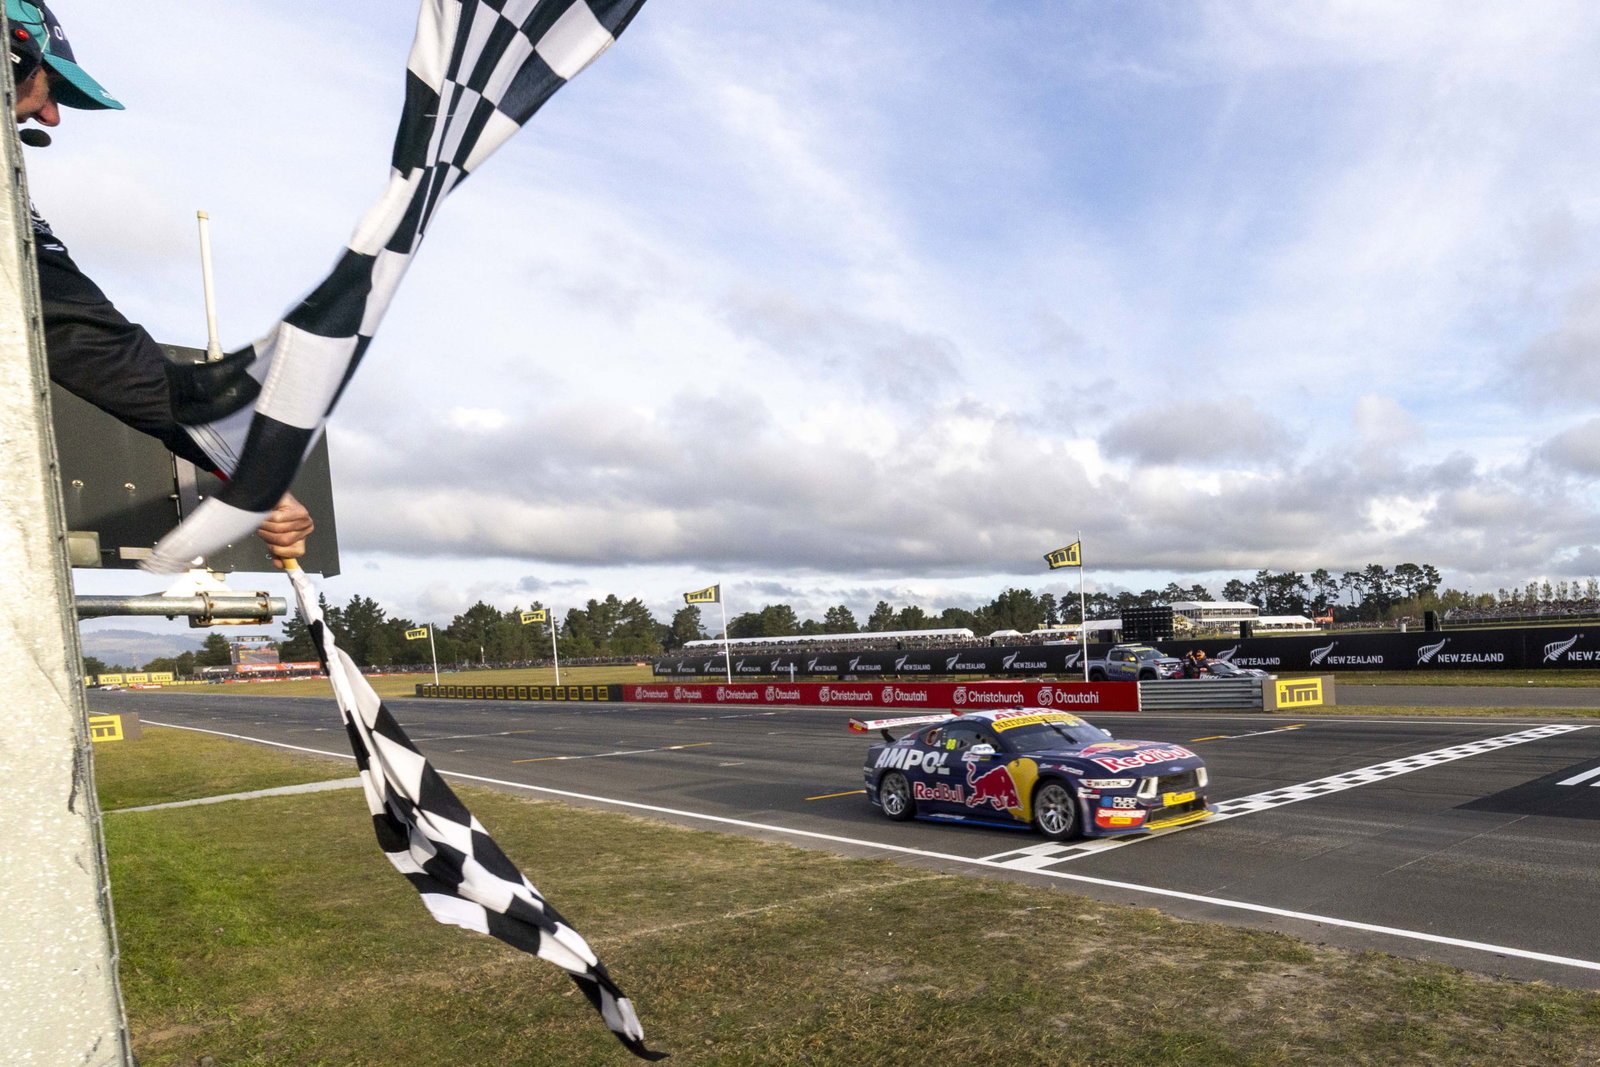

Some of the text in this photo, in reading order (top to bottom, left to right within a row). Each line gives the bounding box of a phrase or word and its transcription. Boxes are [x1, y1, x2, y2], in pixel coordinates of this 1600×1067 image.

[1327, 655, 1384, 664] NEW ZEALAND
[1437, 653, 1505, 663] NEW ZEALAND
[1568, 651, 1593, 660] NEW
[1248, 657, 1281, 665] ZEALAND
[726, 689, 758, 699] Christchurch
[831, 690, 873, 700] Christchurch
[968, 691, 1024, 703] Christchurch
[1055, 689, 1099, 704] Ōtautahi
[874, 747, 950, 776] AMPOL
